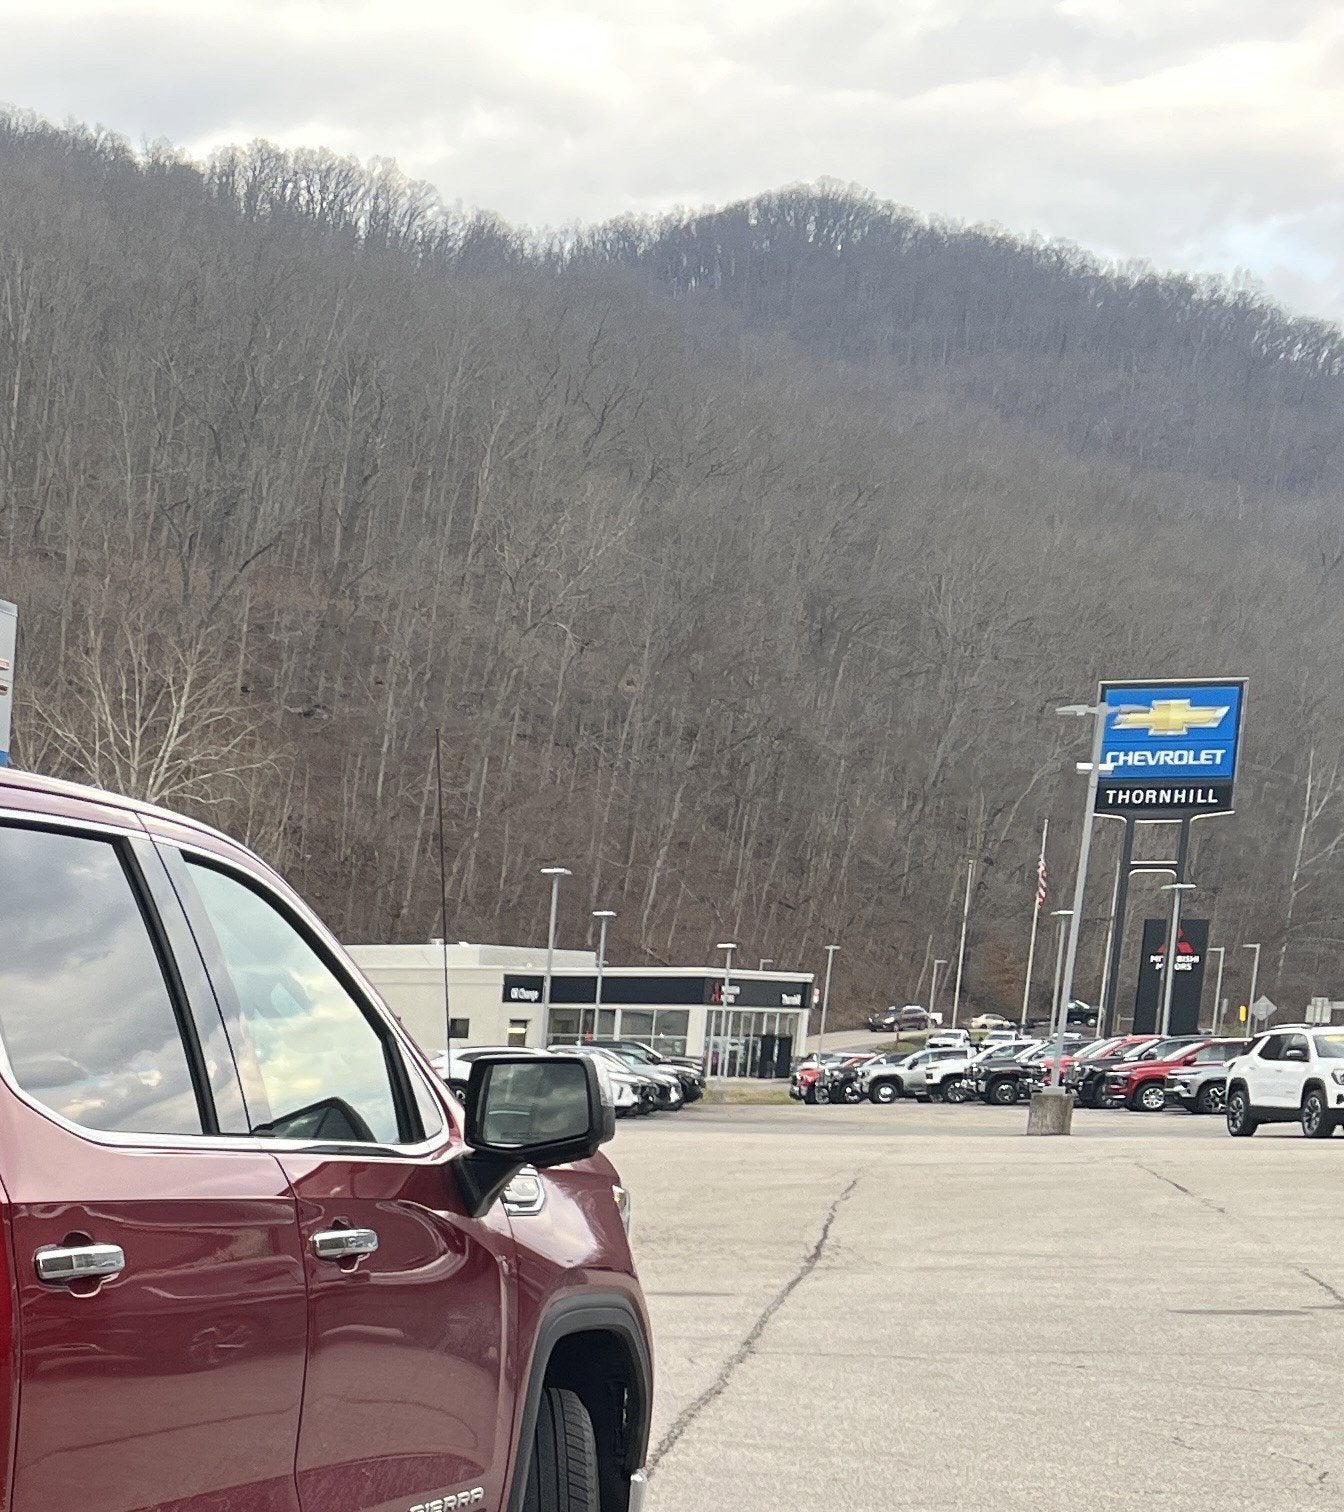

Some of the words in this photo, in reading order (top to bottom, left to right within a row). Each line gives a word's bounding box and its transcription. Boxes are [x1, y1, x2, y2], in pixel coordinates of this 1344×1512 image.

[1105, 749, 1226, 766] CHEVROLET
[1105, 788, 1219, 804] THORNHILL
[1150, 954, 1200, 963] MITBISHI
